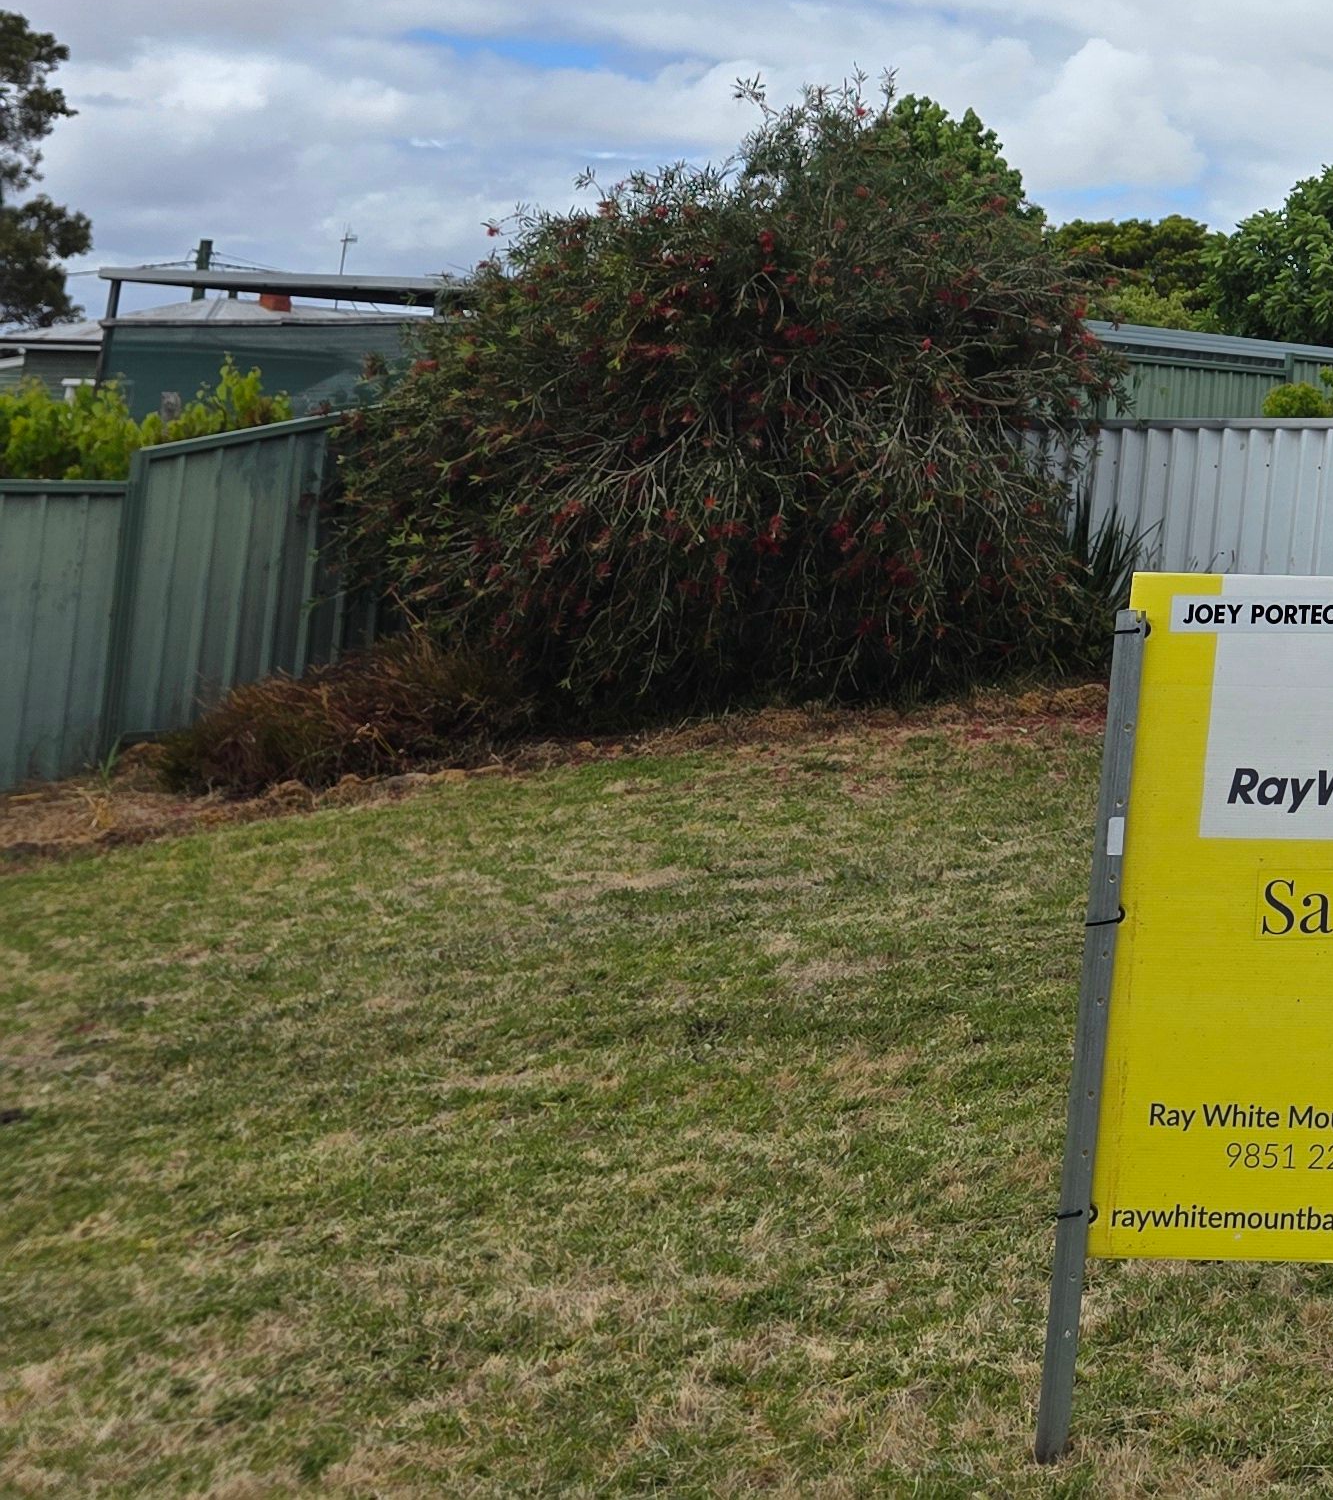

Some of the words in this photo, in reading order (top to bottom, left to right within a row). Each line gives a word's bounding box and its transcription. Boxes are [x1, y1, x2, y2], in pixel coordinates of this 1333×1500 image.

[1182, 603, 1244, 625] JOEY
[1149, 1102, 1197, 1132] Ray
[1202, 1103, 1280, 1129] White
[1226, 1142, 1296, 1169] 9851
